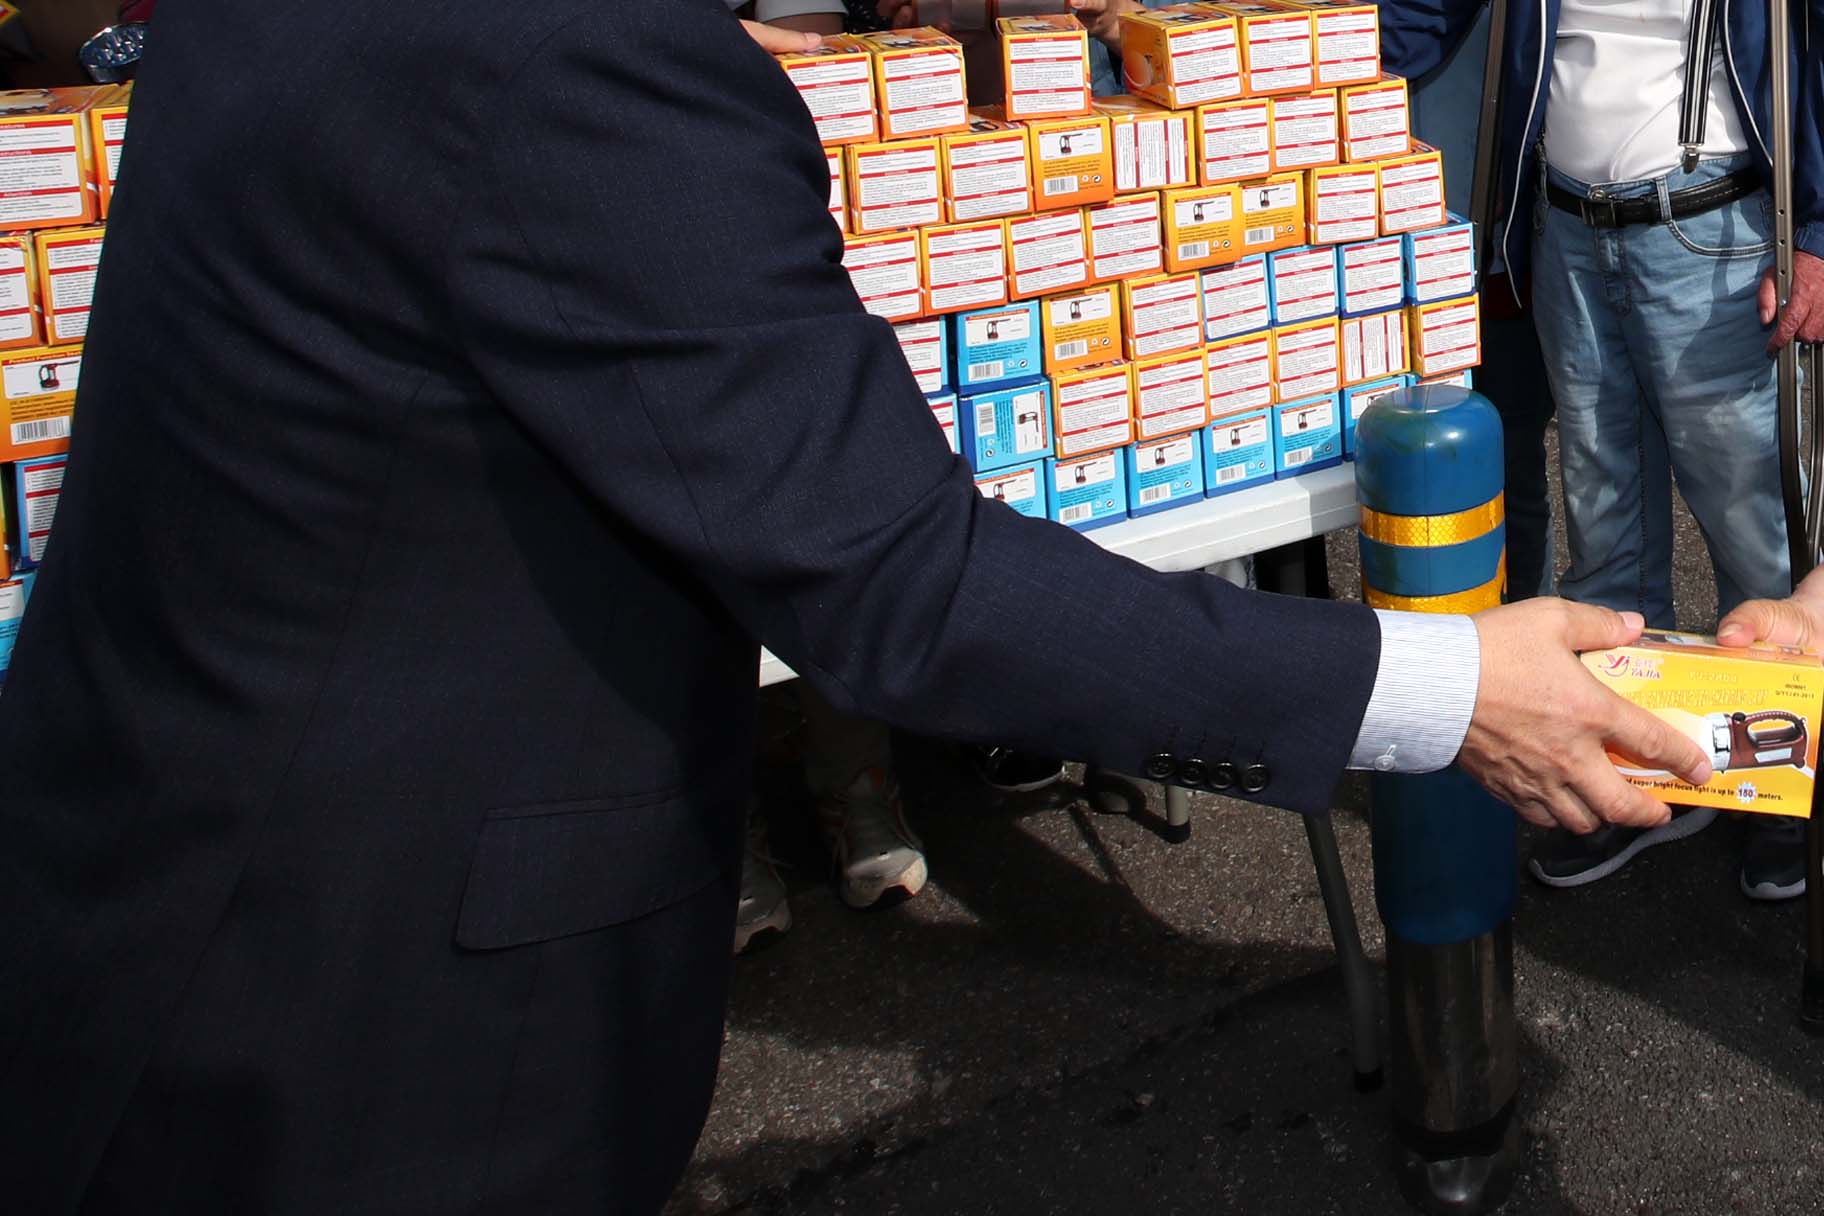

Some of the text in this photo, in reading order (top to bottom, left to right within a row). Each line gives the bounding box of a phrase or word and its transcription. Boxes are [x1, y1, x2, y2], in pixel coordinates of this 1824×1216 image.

[1633, 779, 1652, 787] super
[1653, 780, 1674, 790] bright
[1674, 782, 1693, 791] focus
[1693, 785, 1710, 794] light
[1727, 788, 1735, 796] to
